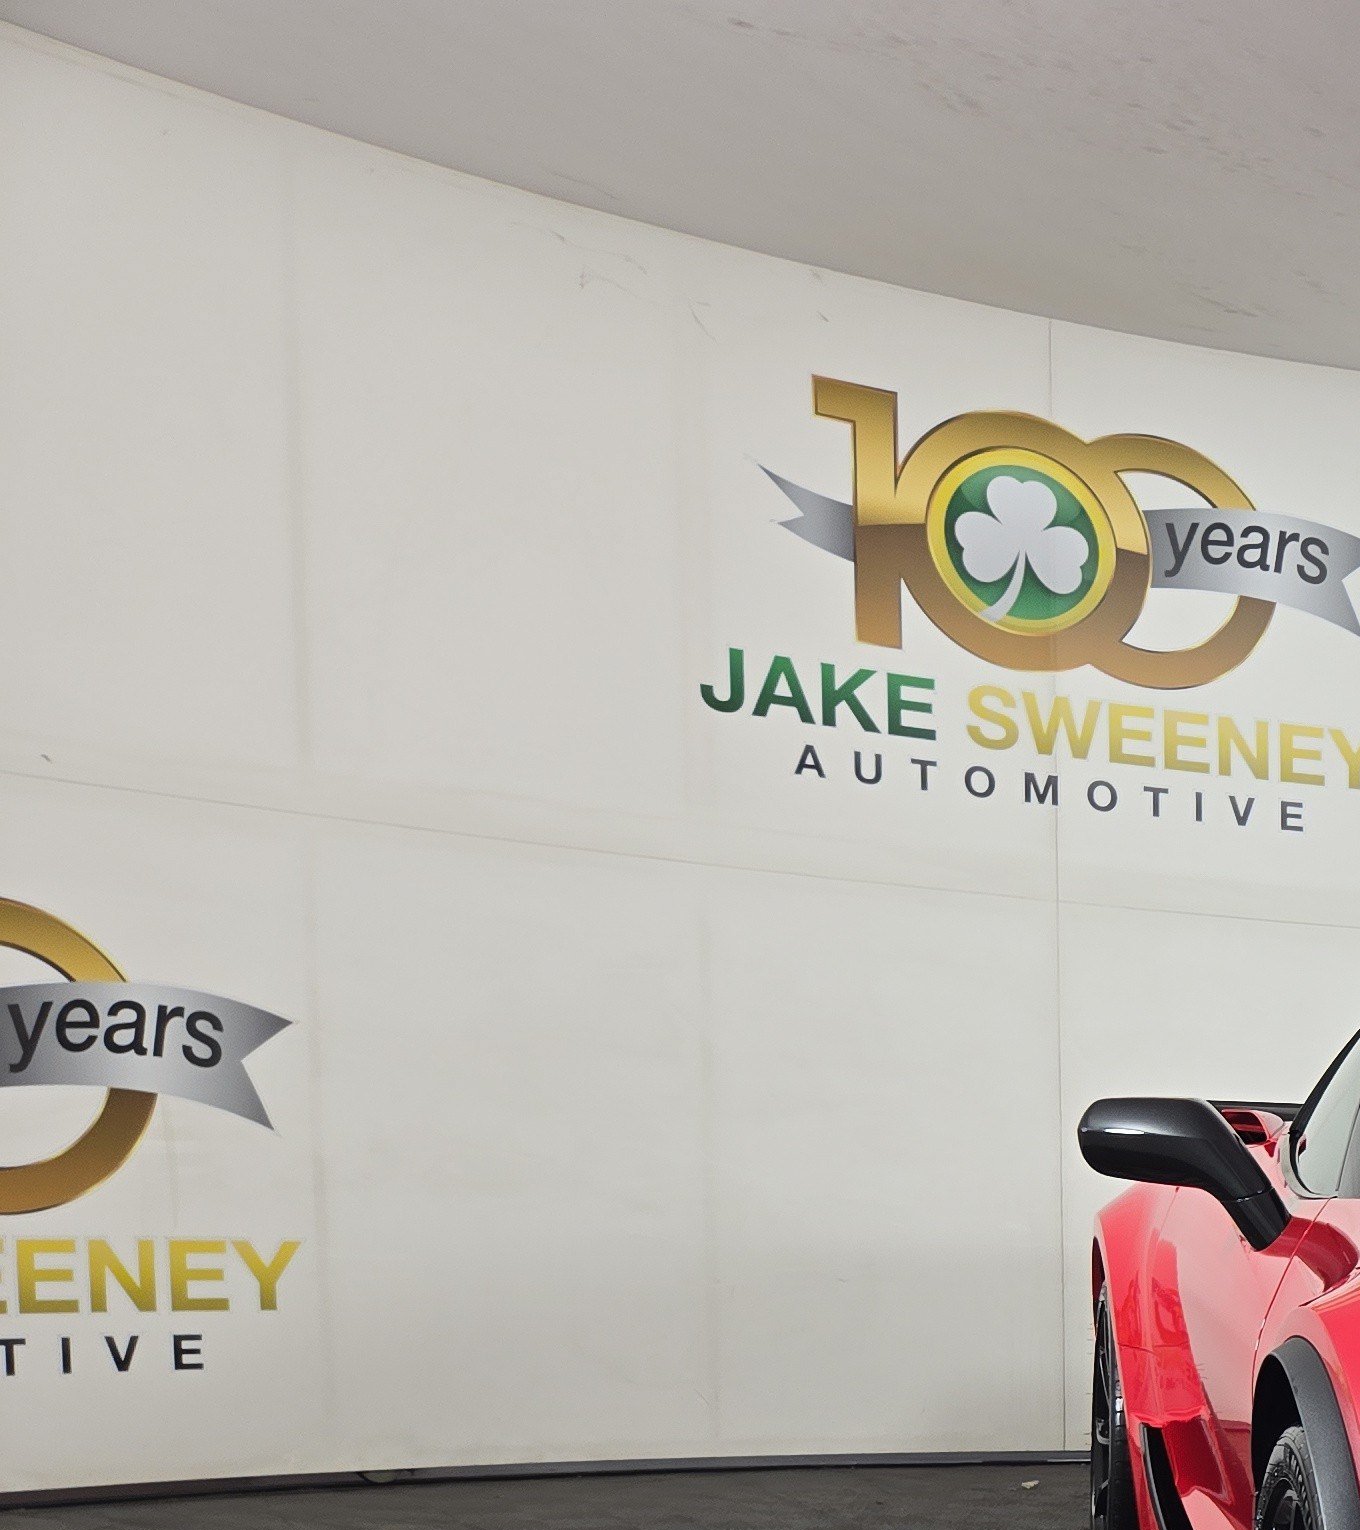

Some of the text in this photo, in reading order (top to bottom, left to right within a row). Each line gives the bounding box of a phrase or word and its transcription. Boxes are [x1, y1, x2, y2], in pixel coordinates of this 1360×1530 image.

[812, 374, 1330, 690] 100 years
[699, 647, 937, 741] JAKE
[794, 744, 1305, 832] AUTOMOTIVE
[8, 998, 223, 1073] years
